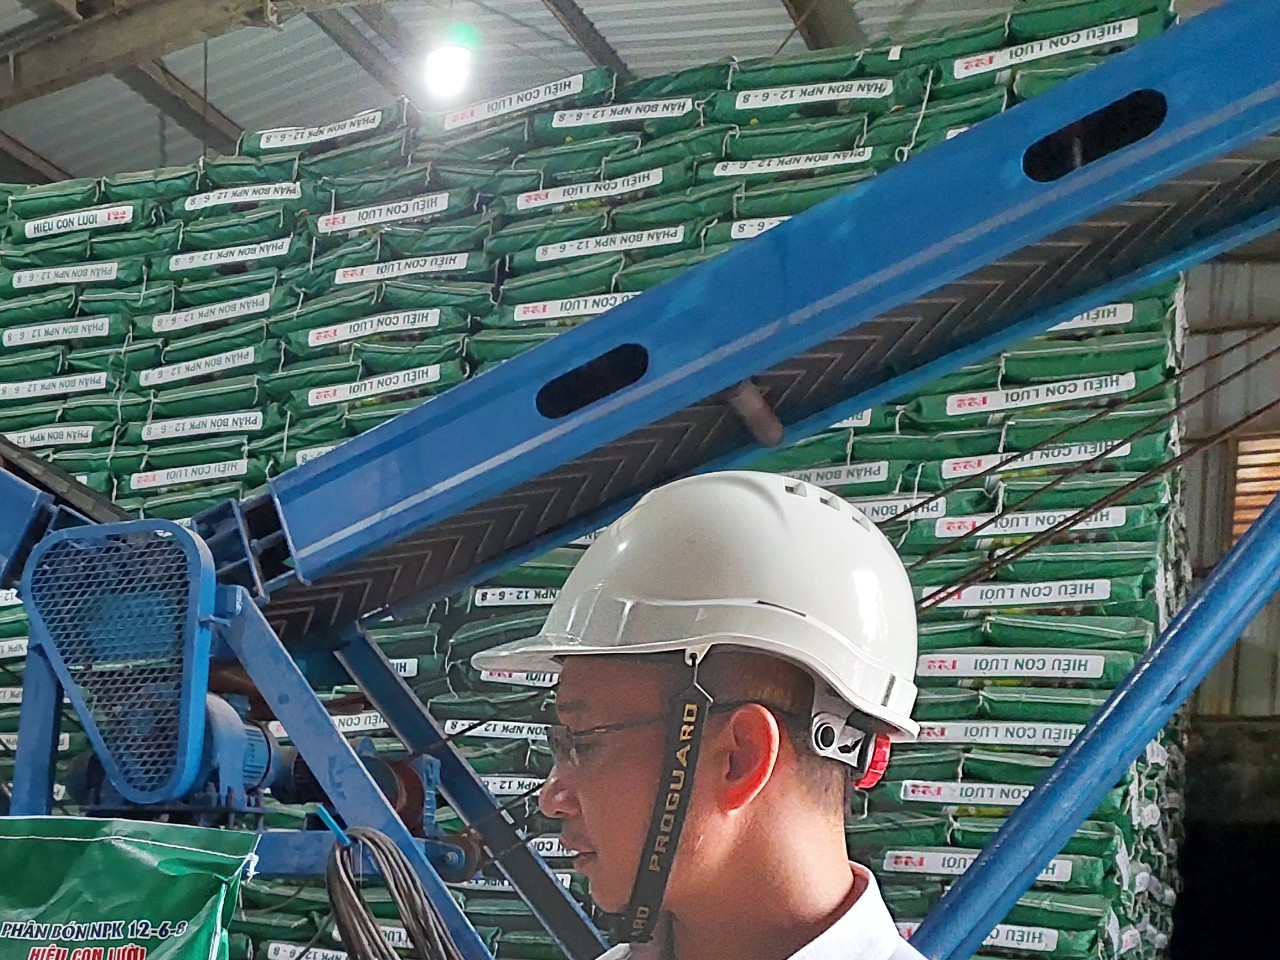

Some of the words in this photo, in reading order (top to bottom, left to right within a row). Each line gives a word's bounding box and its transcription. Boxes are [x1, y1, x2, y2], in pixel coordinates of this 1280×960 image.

[1049, 34, 1081, 48] CON
[516, 88, 540, 104] CON
[800, 86, 823, 97] NPK
[609, 106, 632, 117] NPK
[386, 203, 409, 216] CON
[56, 217, 75, 230] CON
[594, 236, 616, 247] NPK
[404, 259, 427, 270] CON
[376, 315, 400, 327] CON
[376, 375, 400, 388] CON
[1045, 382, 1078, 397] CON
[1021, 585, 1052, 598] CON
[1014, 658, 1046, 671] CON
[1005, 727, 1036, 739] CON
[648, 703, 698, 872] PROGUARD
[0, 920, 49, 940] PHÂN
[50, 920, 88, 941] BÓN
[89, 921, 124, 940] NPK
